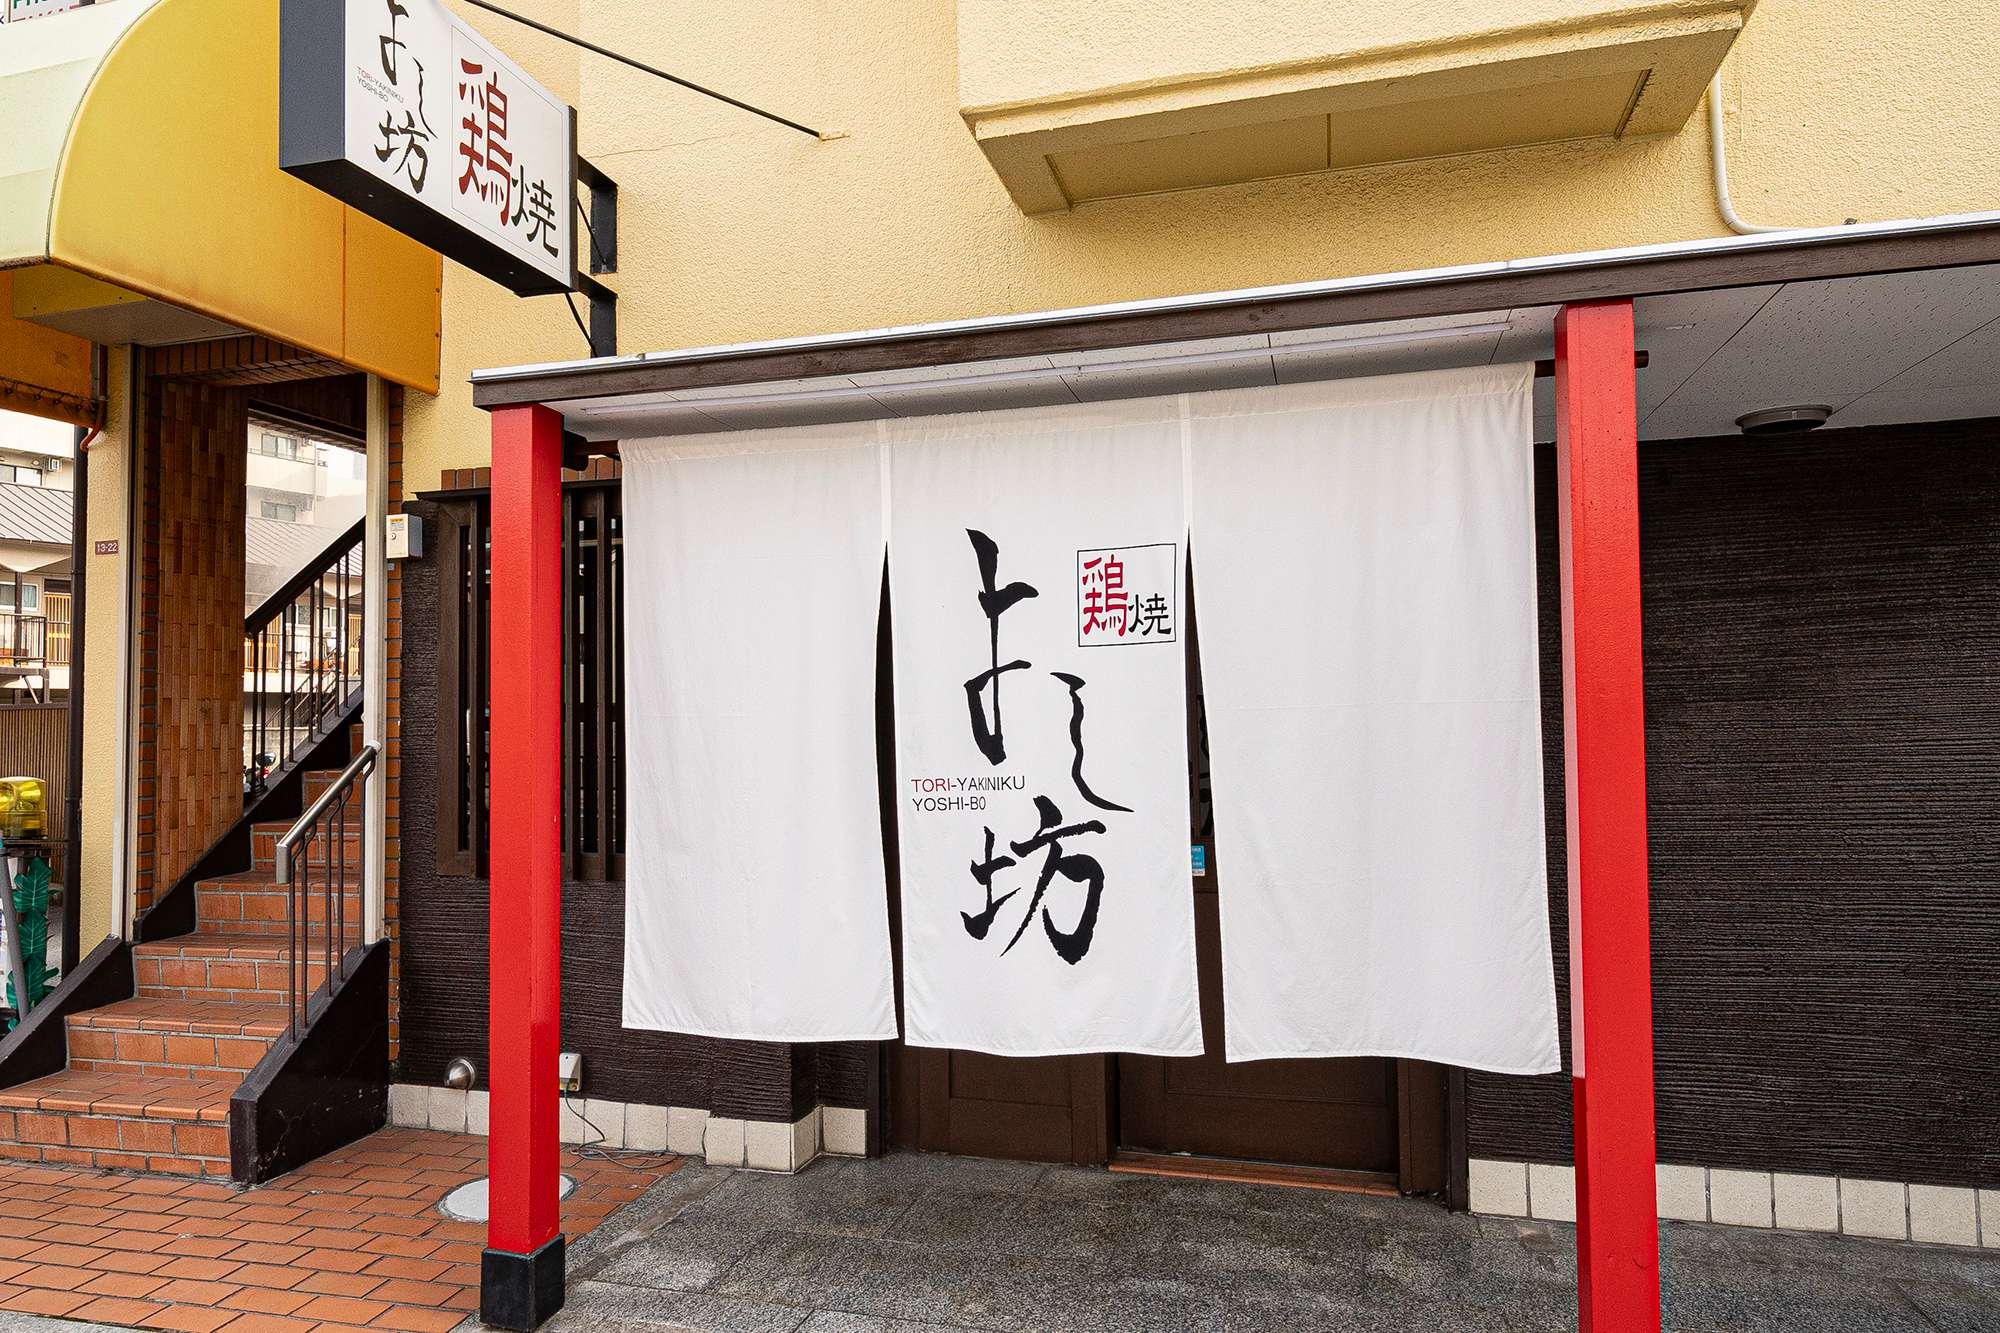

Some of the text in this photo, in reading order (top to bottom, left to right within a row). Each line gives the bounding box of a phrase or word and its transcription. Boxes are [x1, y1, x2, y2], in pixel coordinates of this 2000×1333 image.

[458, 57, 559, 258] 鶏焼
[96, 542, 117, 553] 13-22
[1082, 553, 1172, 637] 鶏焼
[959, 528, 1134, 966] よし坊
[911, 775, 1026, 793] TORI-YAKINIKU
[912, 796, 987, 812] YOSHI-BO
